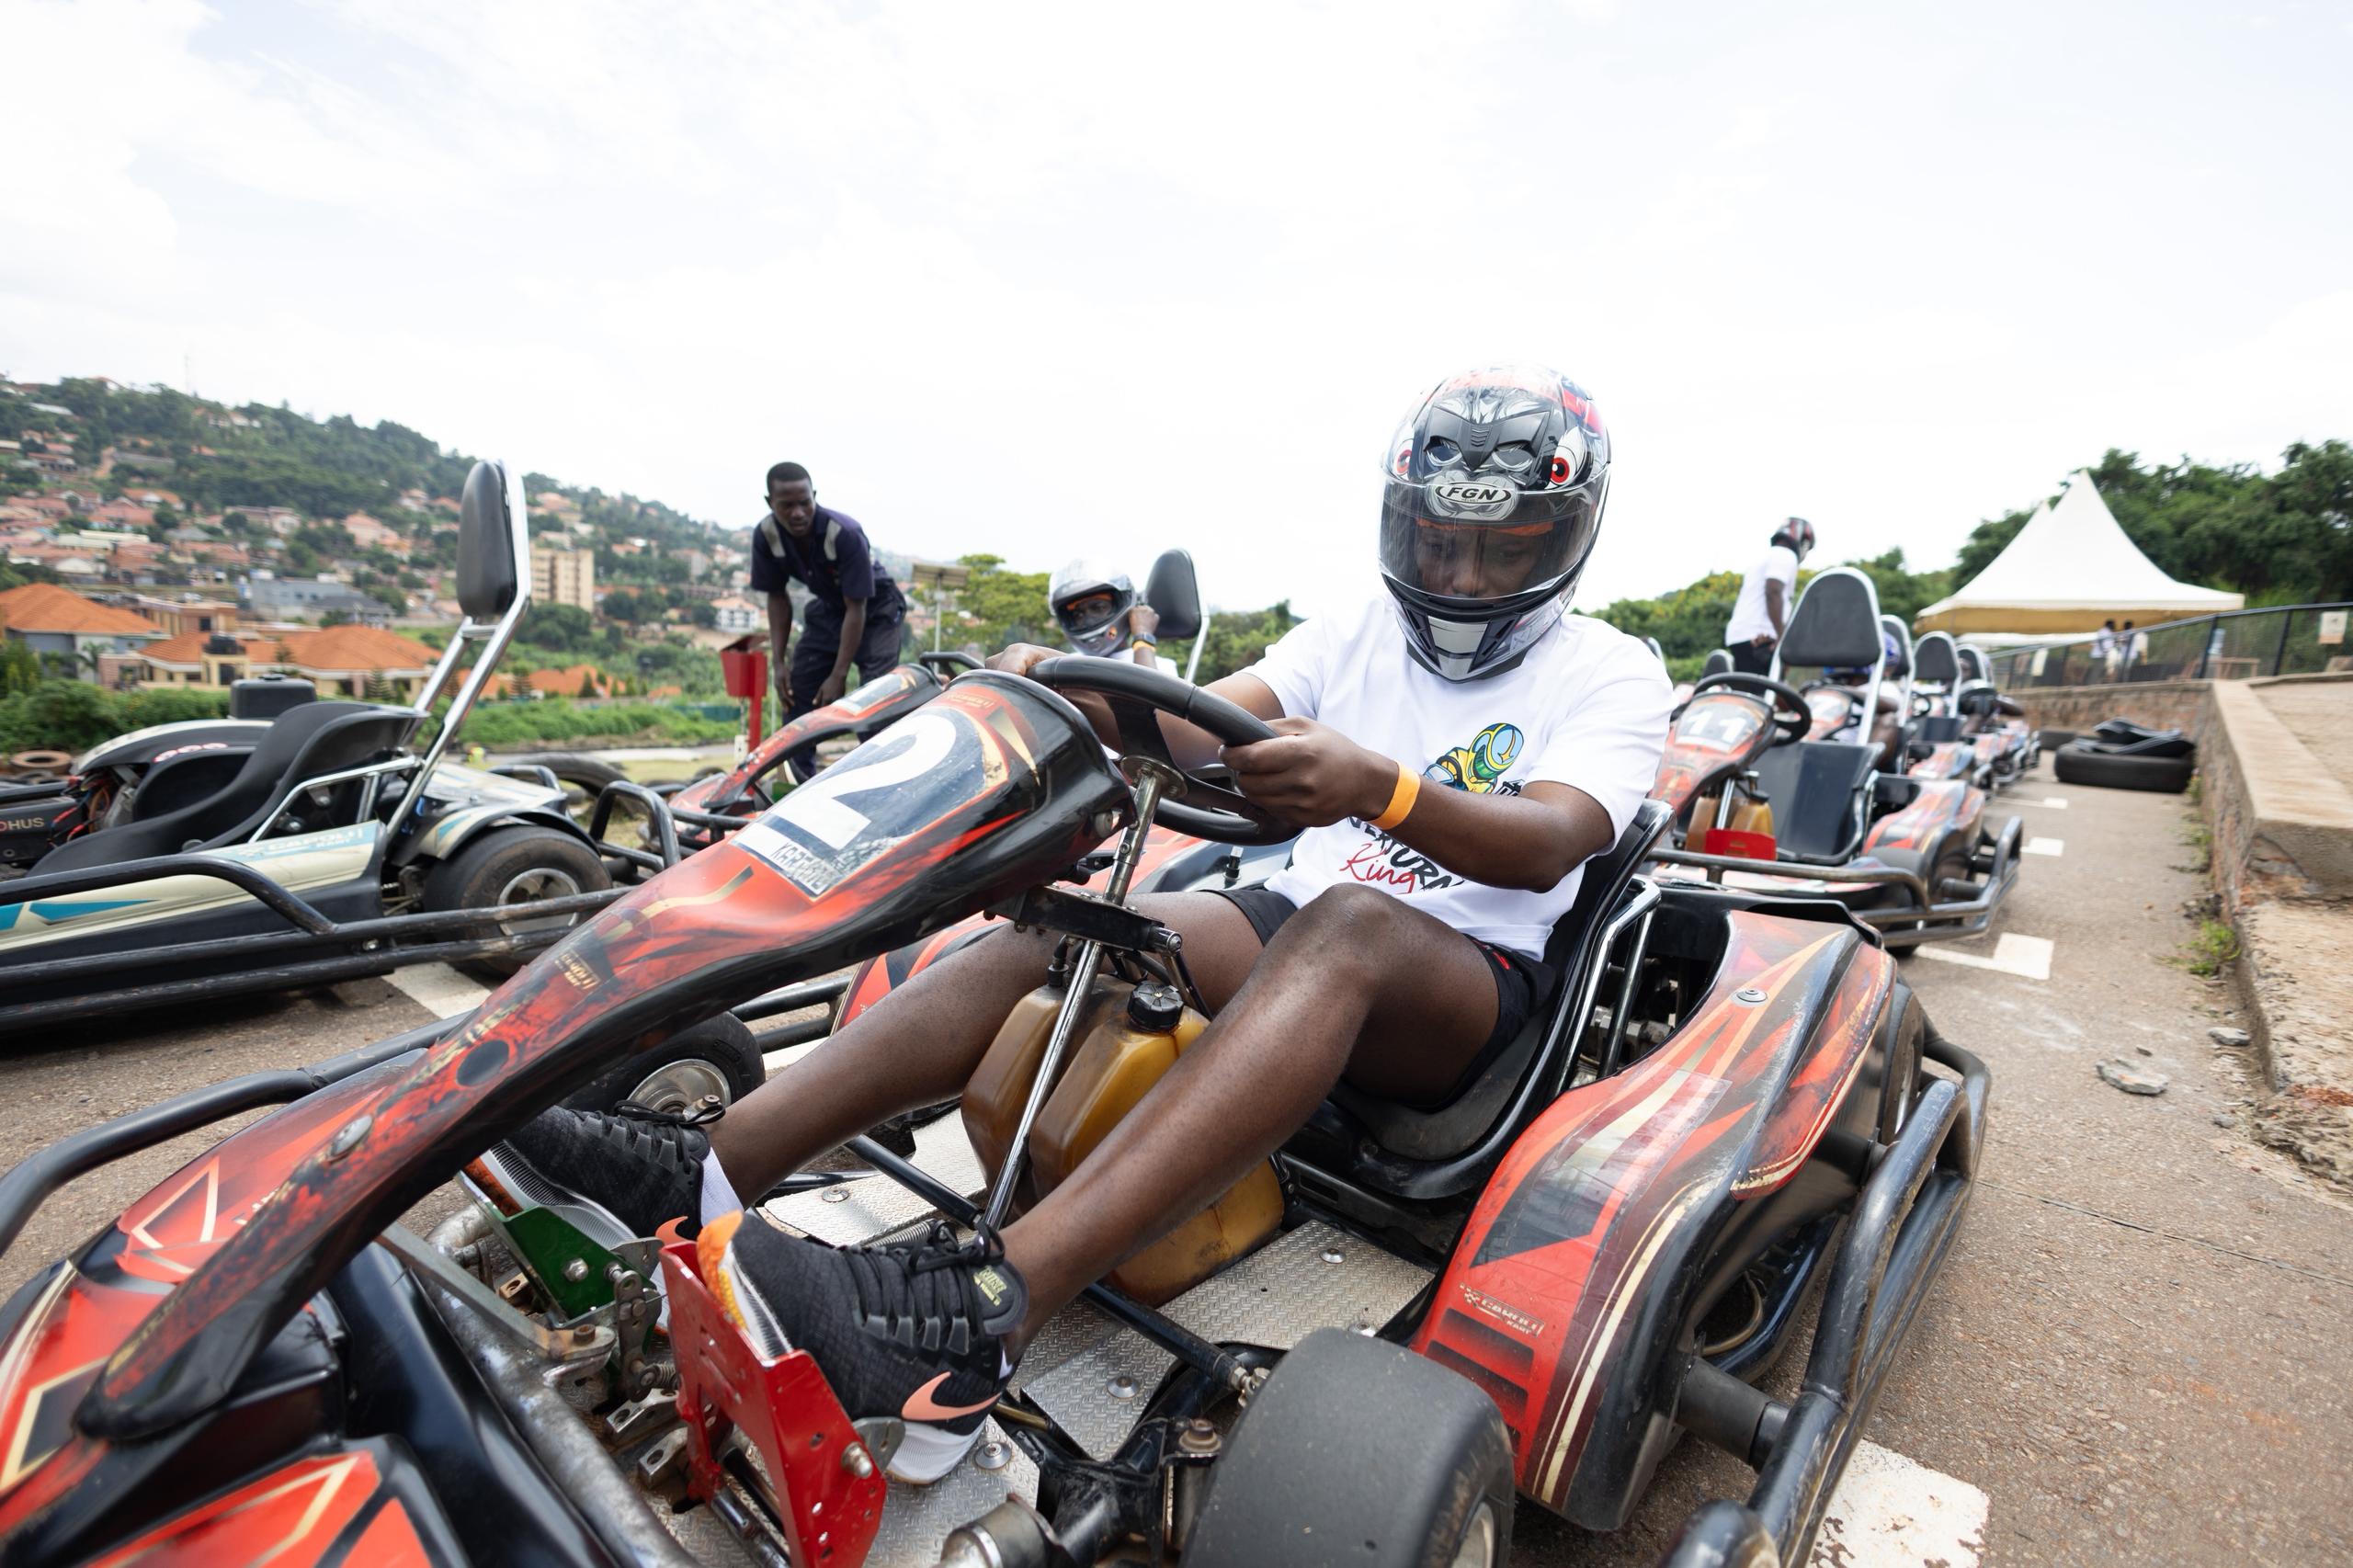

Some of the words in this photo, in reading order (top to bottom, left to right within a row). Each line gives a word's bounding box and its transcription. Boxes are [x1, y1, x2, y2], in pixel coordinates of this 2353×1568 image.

[1447, 487, 1499, 500] FGN
[1686, 710, 1746, 742] 11
[768, 713, 957, 850] 2
[1339, 843, 1416, 894] King
